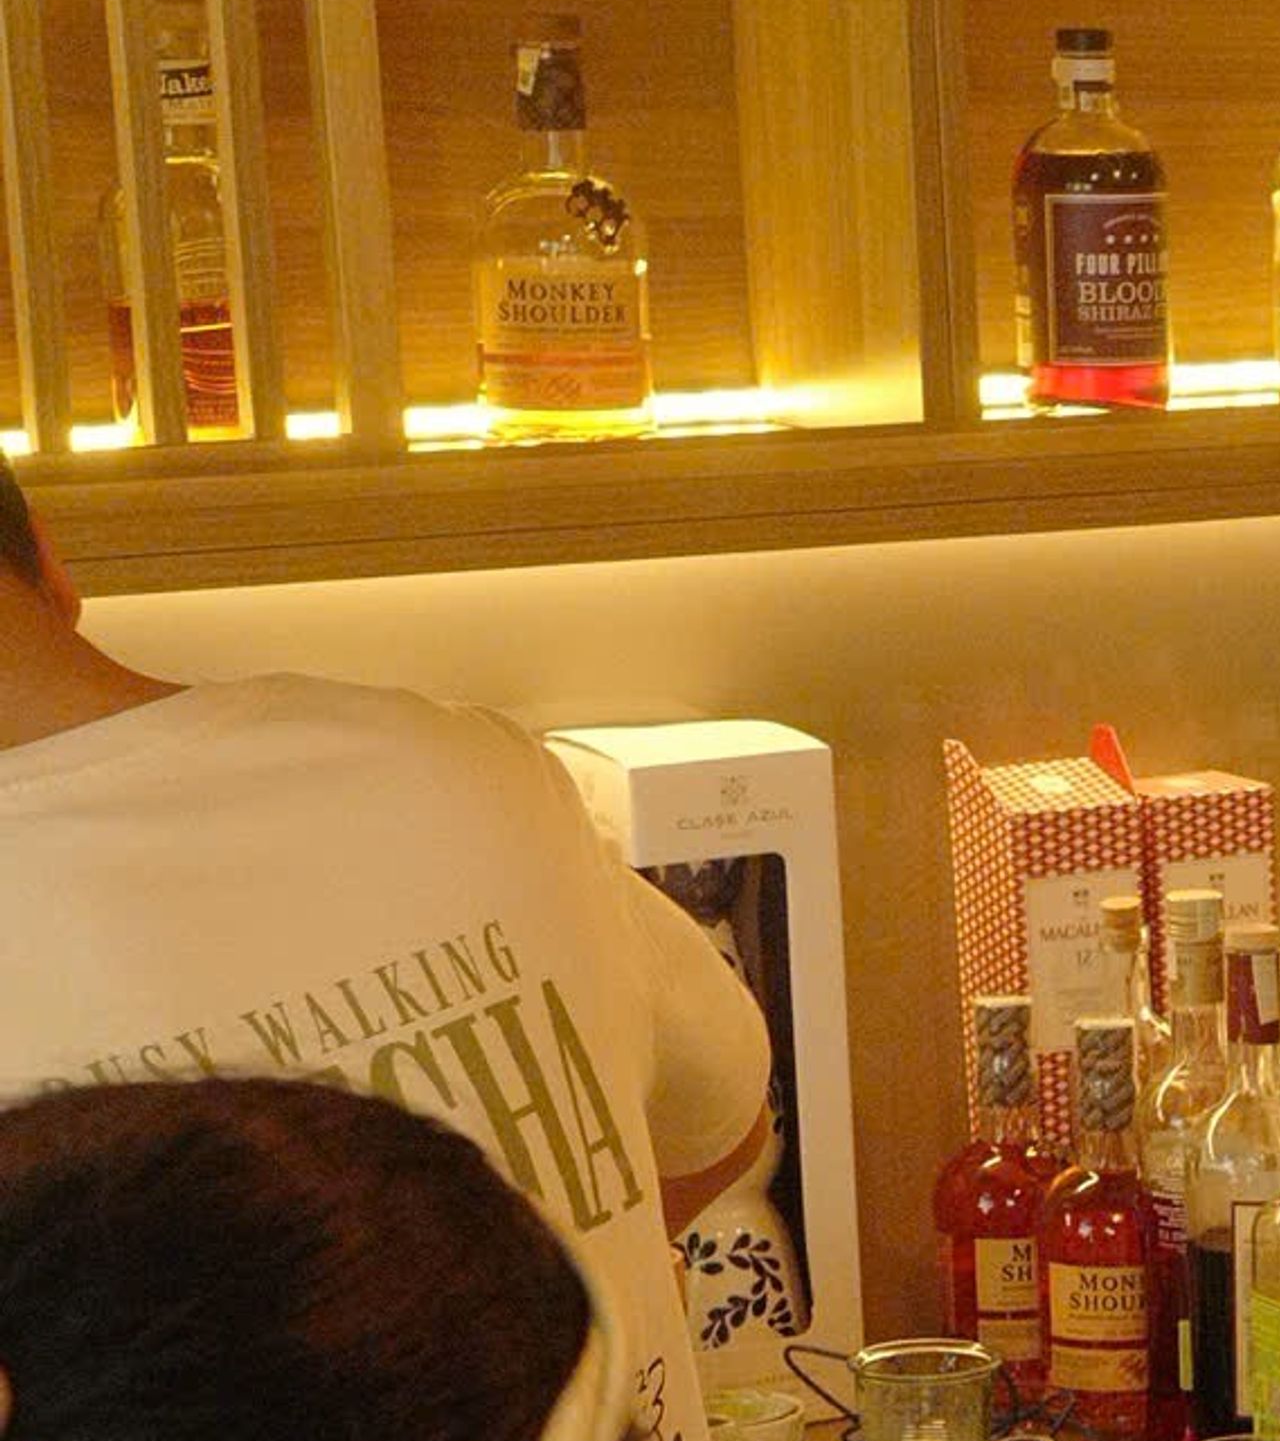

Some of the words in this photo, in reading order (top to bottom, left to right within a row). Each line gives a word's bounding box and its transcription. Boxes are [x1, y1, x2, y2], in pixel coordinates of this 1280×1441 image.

[1076, 252, 1120, 276] FOUR
[508, 279, 614, 302] MONKEY
[240, 919, 521, 1068] WALKING
